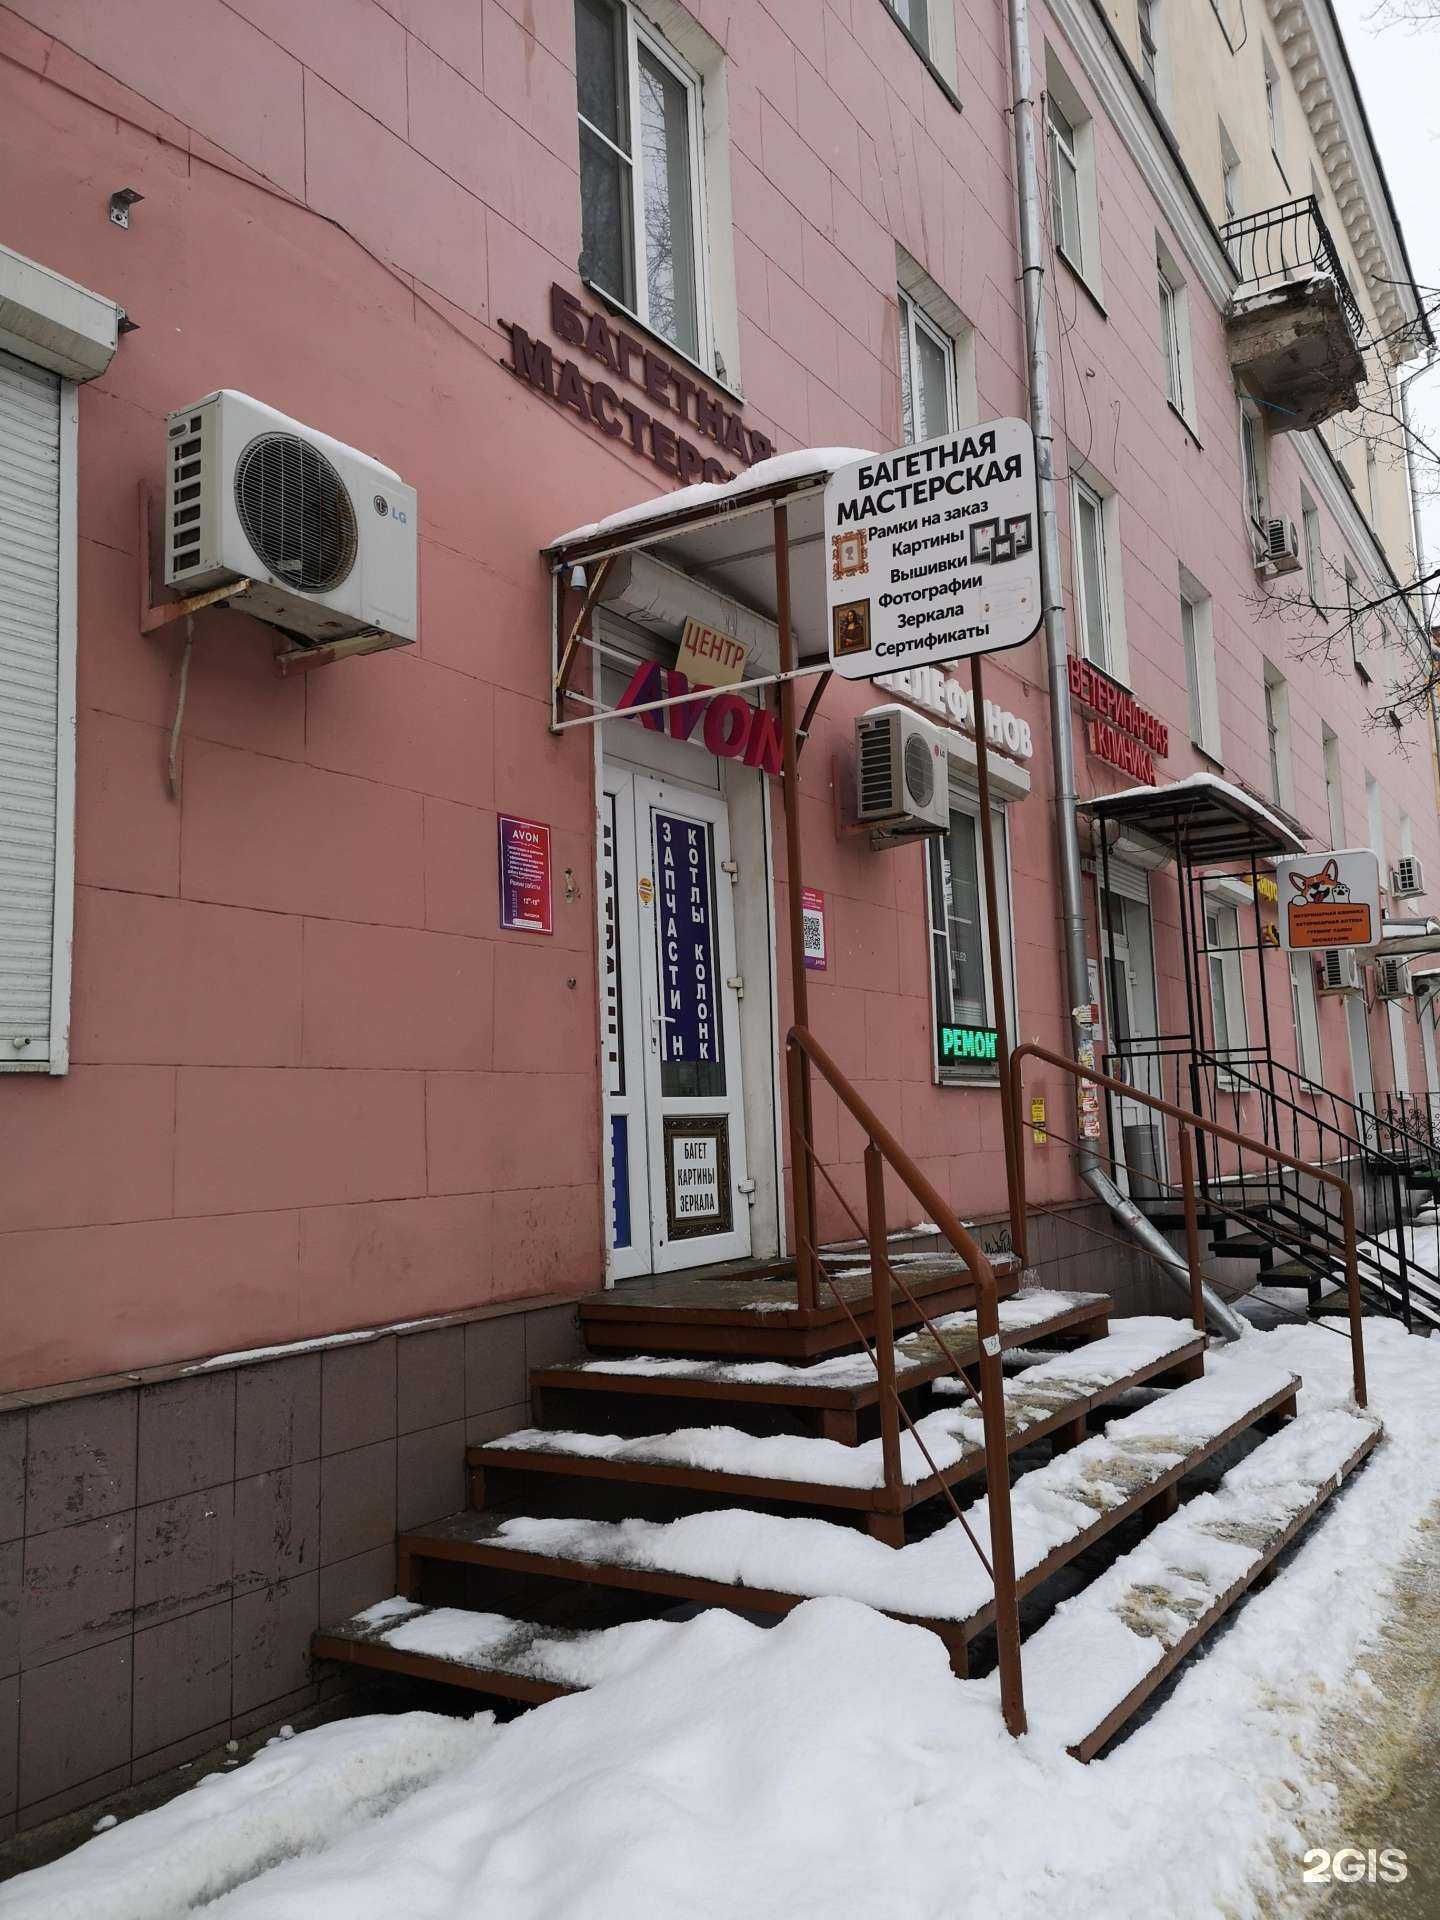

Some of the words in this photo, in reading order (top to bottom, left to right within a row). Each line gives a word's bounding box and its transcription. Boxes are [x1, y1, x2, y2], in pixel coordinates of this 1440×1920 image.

[551, 281, 774, 467] БАГЕТНАЯ
[511, 322, 737, 484] МАСТЕРС
[858, 430, 996, 490] БАГЕТНАЯ
[837, 454, 1022, 525] МАСТЕРСКАЯ
[392, 507, 406, 523] LG
[868, 517, 918, 541] Рамки
[921, 514, 941, 527] на
[944, 501, 989, 522] заказ
[892, 530, 965, 557] Картины
[878, 576, 983, 608] Фотографии
[890, 556, 968, 584] Вышивки
[897, 604, 964, 629] Зеркала
[684, 623, 745, 669] ЦЕНТР
[875, 624, 989, 657] Сертификаты
[615, 660, 784, 776] AVON
[873, 664, 1033, 759] ЕЛЕФНОВ
[1067, 655, 1168, 758] ВЕТЕРИНАРНАЯ
[1093, 720, 1157, 787] КЛИНИКА
[512, 829, 539, 843] AVON
[687, 828, 705, 924] КОТЛЫ
[662, 822, 681, 1010] ЗАПЧАСТИ
[694, 943, 709, 1059] КОЛОНК
[684, 1142, 707, 1160] БАГЕТ
[677, 1168, 715, 1186] КАРТИНЫ
[680, 1193, 715, 1212] ЗЕРКАЛА
